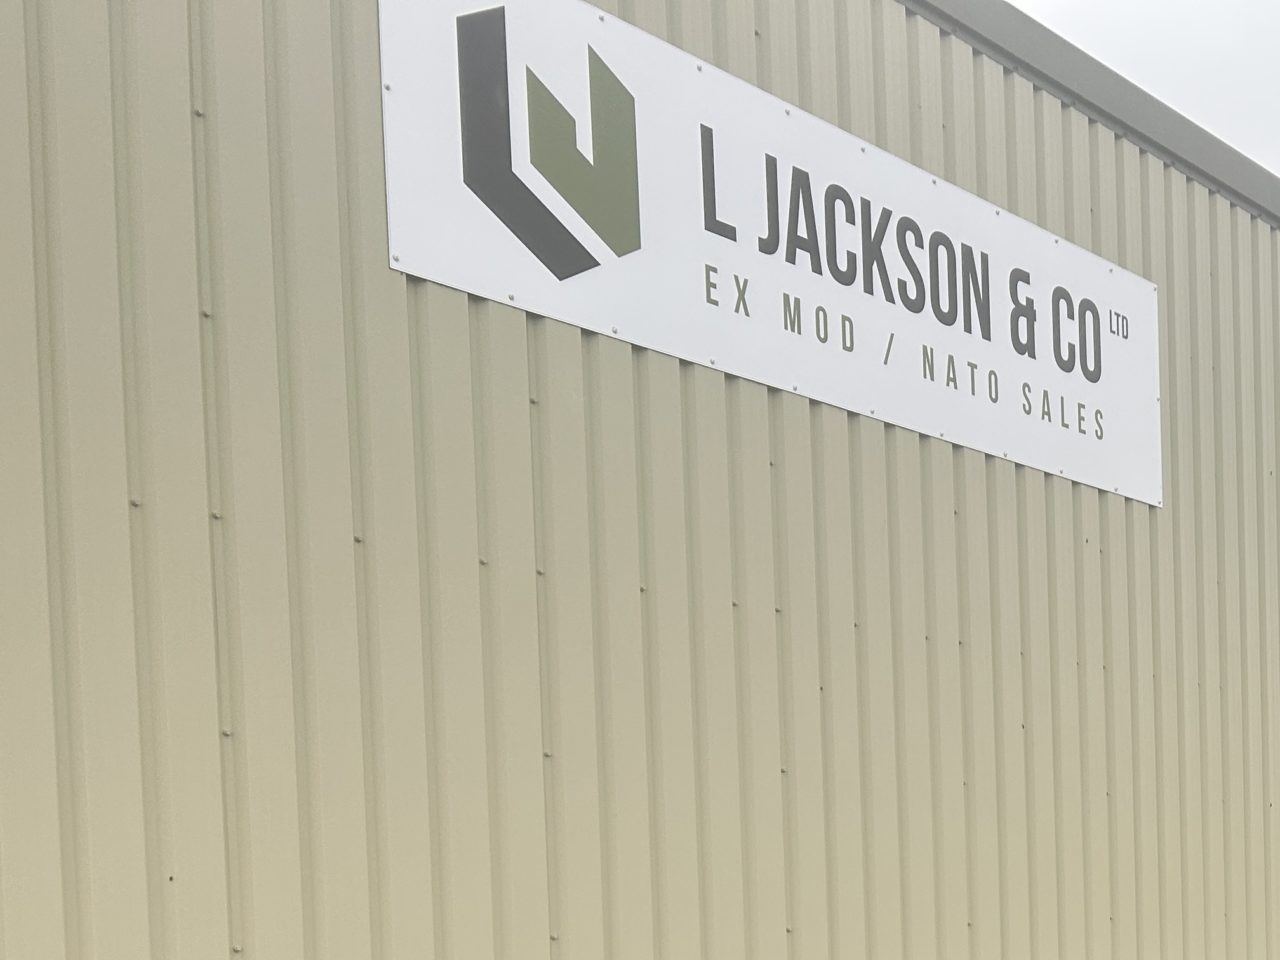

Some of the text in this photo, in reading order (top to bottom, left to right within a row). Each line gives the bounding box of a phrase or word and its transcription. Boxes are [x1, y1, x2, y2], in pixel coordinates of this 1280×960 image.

[699, 123, 1129, 384] L JACKSON & CO LTD
[704, 263, 1105, 442] EX MOD / NATO SALES
